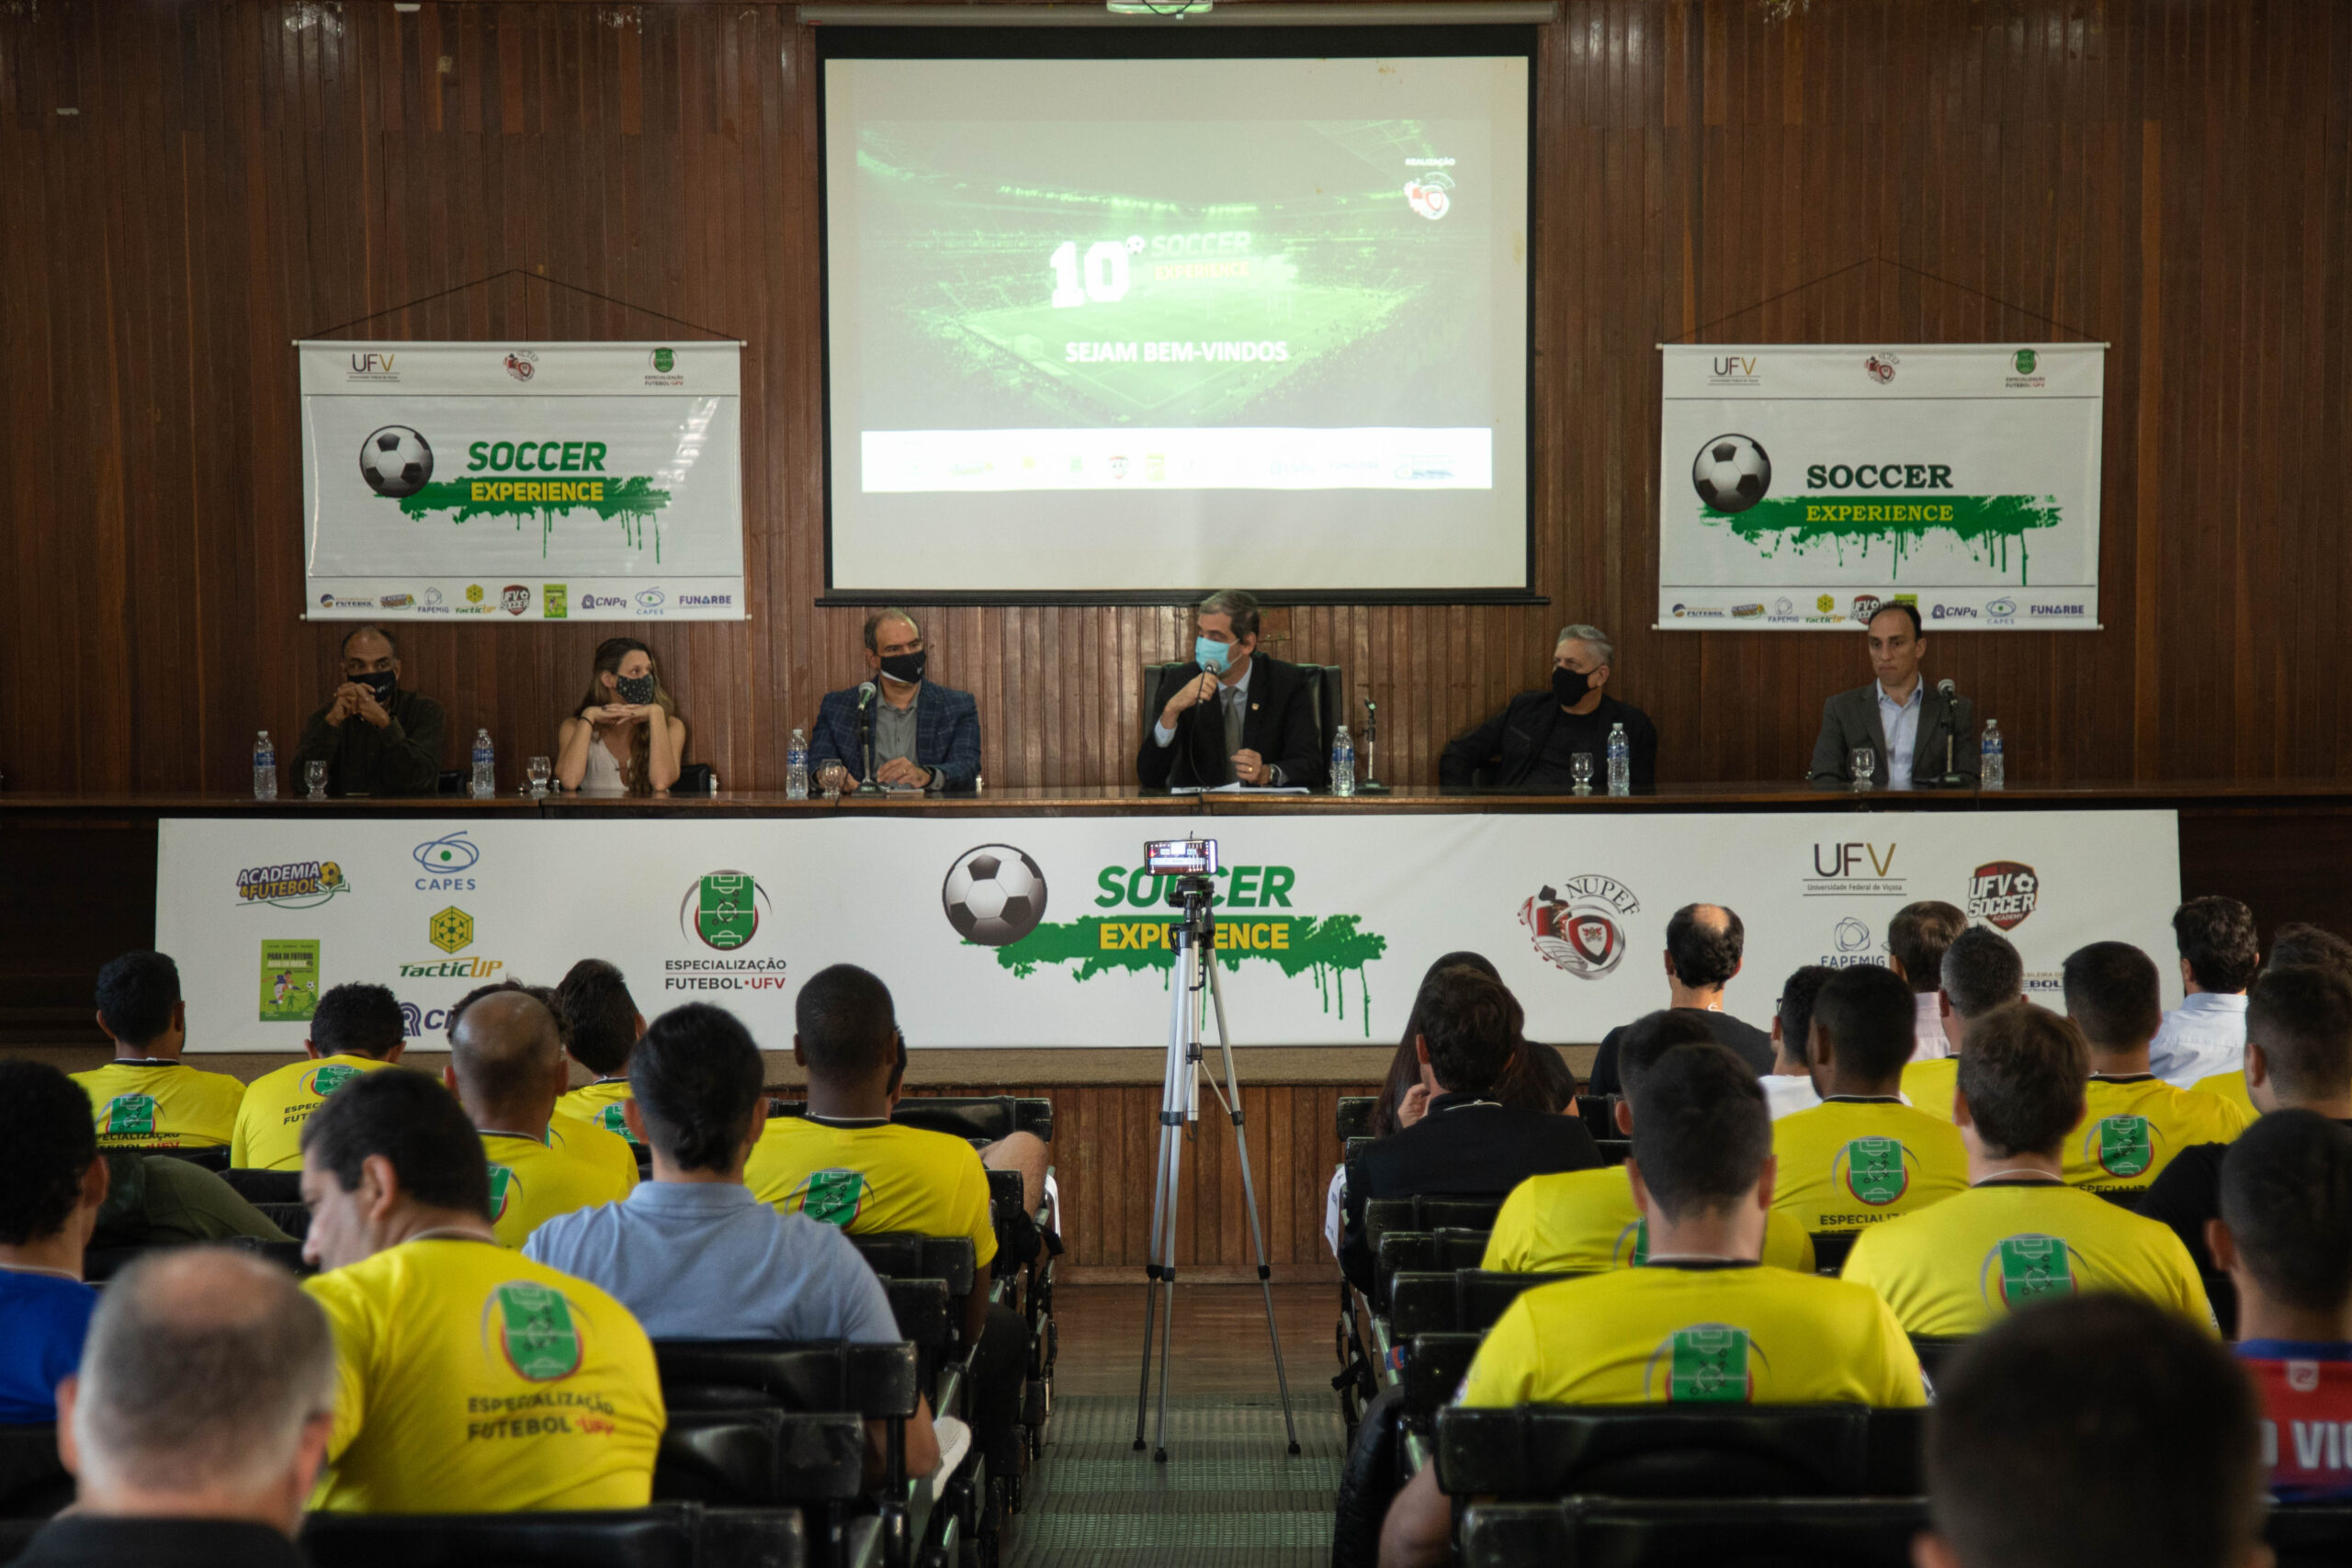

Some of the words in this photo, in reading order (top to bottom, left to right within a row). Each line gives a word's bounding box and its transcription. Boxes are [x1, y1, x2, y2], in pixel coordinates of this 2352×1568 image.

[1151, 231, 1251, 257] SOCCER
[1066, 342, 1137, 363] SEJAM
[1144, 341, 1289, 363] BEM-VINDOS
[352, 353, 395, 372] UFV
[1713, 356, 1757, 376] UFV
[467, 441, 607, 472] SOCCER
[1806, 464, 1954, 489] SOCCER
[471, 481, 604, 502] EXPERIENCE
[1806, 504, 1954, 522] EXPERIENCE
[417, 605, 449, 614] FAPEMIG
[594, 596, 628, 609] CNPq
[678, 594, 732, 605] FUNARBE
[2030, 604, 2085, 615] FUNARBE
[1768, 615, 1800, 624] FAPEMIG
[1946, 606, 1978, 618] CNPq
[1986, 617, 2015, 626] CAPES
[1814, 842, 1896, 878] UFV
[236, 861, 321, 886] ACADEMIA
[414, 878, 477, 891] CAPES
[1969, 873, 2014, 900] UFV
[1565, 877, 1638, 916] NUPEF
[1967, 892, 2036, 918] SOCCER
[1992, 913, 2024, 922] ACADEMY
[1100, 922, 1290, 950] EXPEENCE
[665, 957, 787, 973] ESPECIALIZAÇÃO
[665, 977, 743, 990] FUTEBOL
[468, 1392, 615, 1416] ESPECIALIZAÇÃO
[468, 1416, 572, 1440] FUTEBOL
